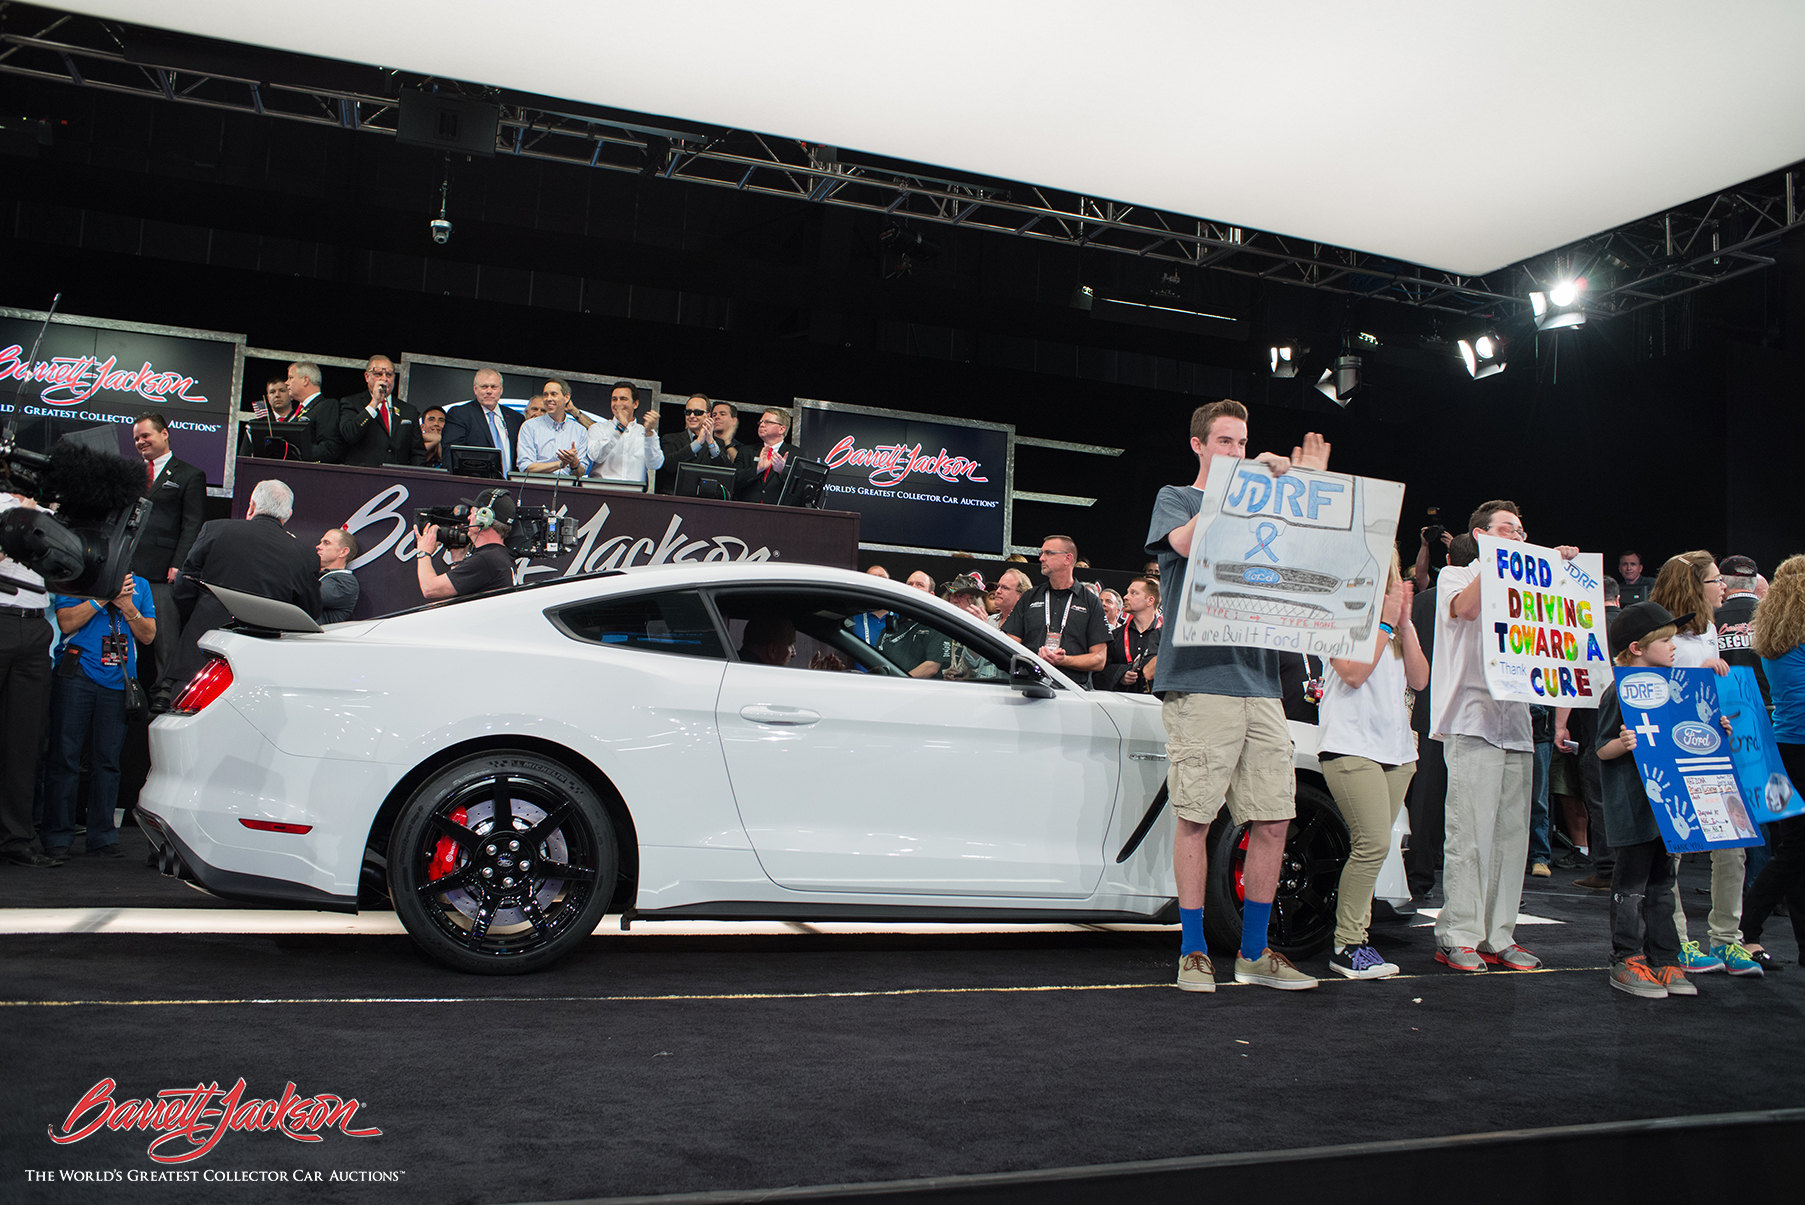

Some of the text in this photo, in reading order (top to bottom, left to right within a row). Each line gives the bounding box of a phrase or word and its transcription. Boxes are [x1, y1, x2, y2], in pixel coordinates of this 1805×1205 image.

[24, 405, 78, 419] GREATEST
[79, 411, 137, 425] COLLECTO
[857, 486, 896, 499] GREATEST
[896, 490, 941, 503] COLLECTOR
[942, 495, 958, 505] CAR
[1228, 470, 1345, 520] JDRF
[1496, 548, 1552, 588] FORD
[1563, 560, 1599, 590] JDRF
[1206, 606, 1230, 619] TYPE
[1280, 617, 1308, 627] TYPE
[1313, 620, 1336, 629] NONE
[1508, 587, 1593, 629] DRIVING
[1182, 625, 1197, 641] We
[1201, 629, 1219, 642] are
[1222, 624, 1259, 643] Built
[1263, 627, 1300, 648] Ford
[1494, 622, 1606, 662] TOWARD A
[1718, 635, 1754, 649] SECU
[1499, 661, 1527, 676] Thank
[1530, 666, 1593, 698] CURE
[1622, 683, 1654, 699] JDRF
[1683, 727, 1711, 747] Ford
[1729, 711, 1761, 752] ord
[523, 761, 566, 783] MICHELIN
[1745, 787, 1762, 809] RF
